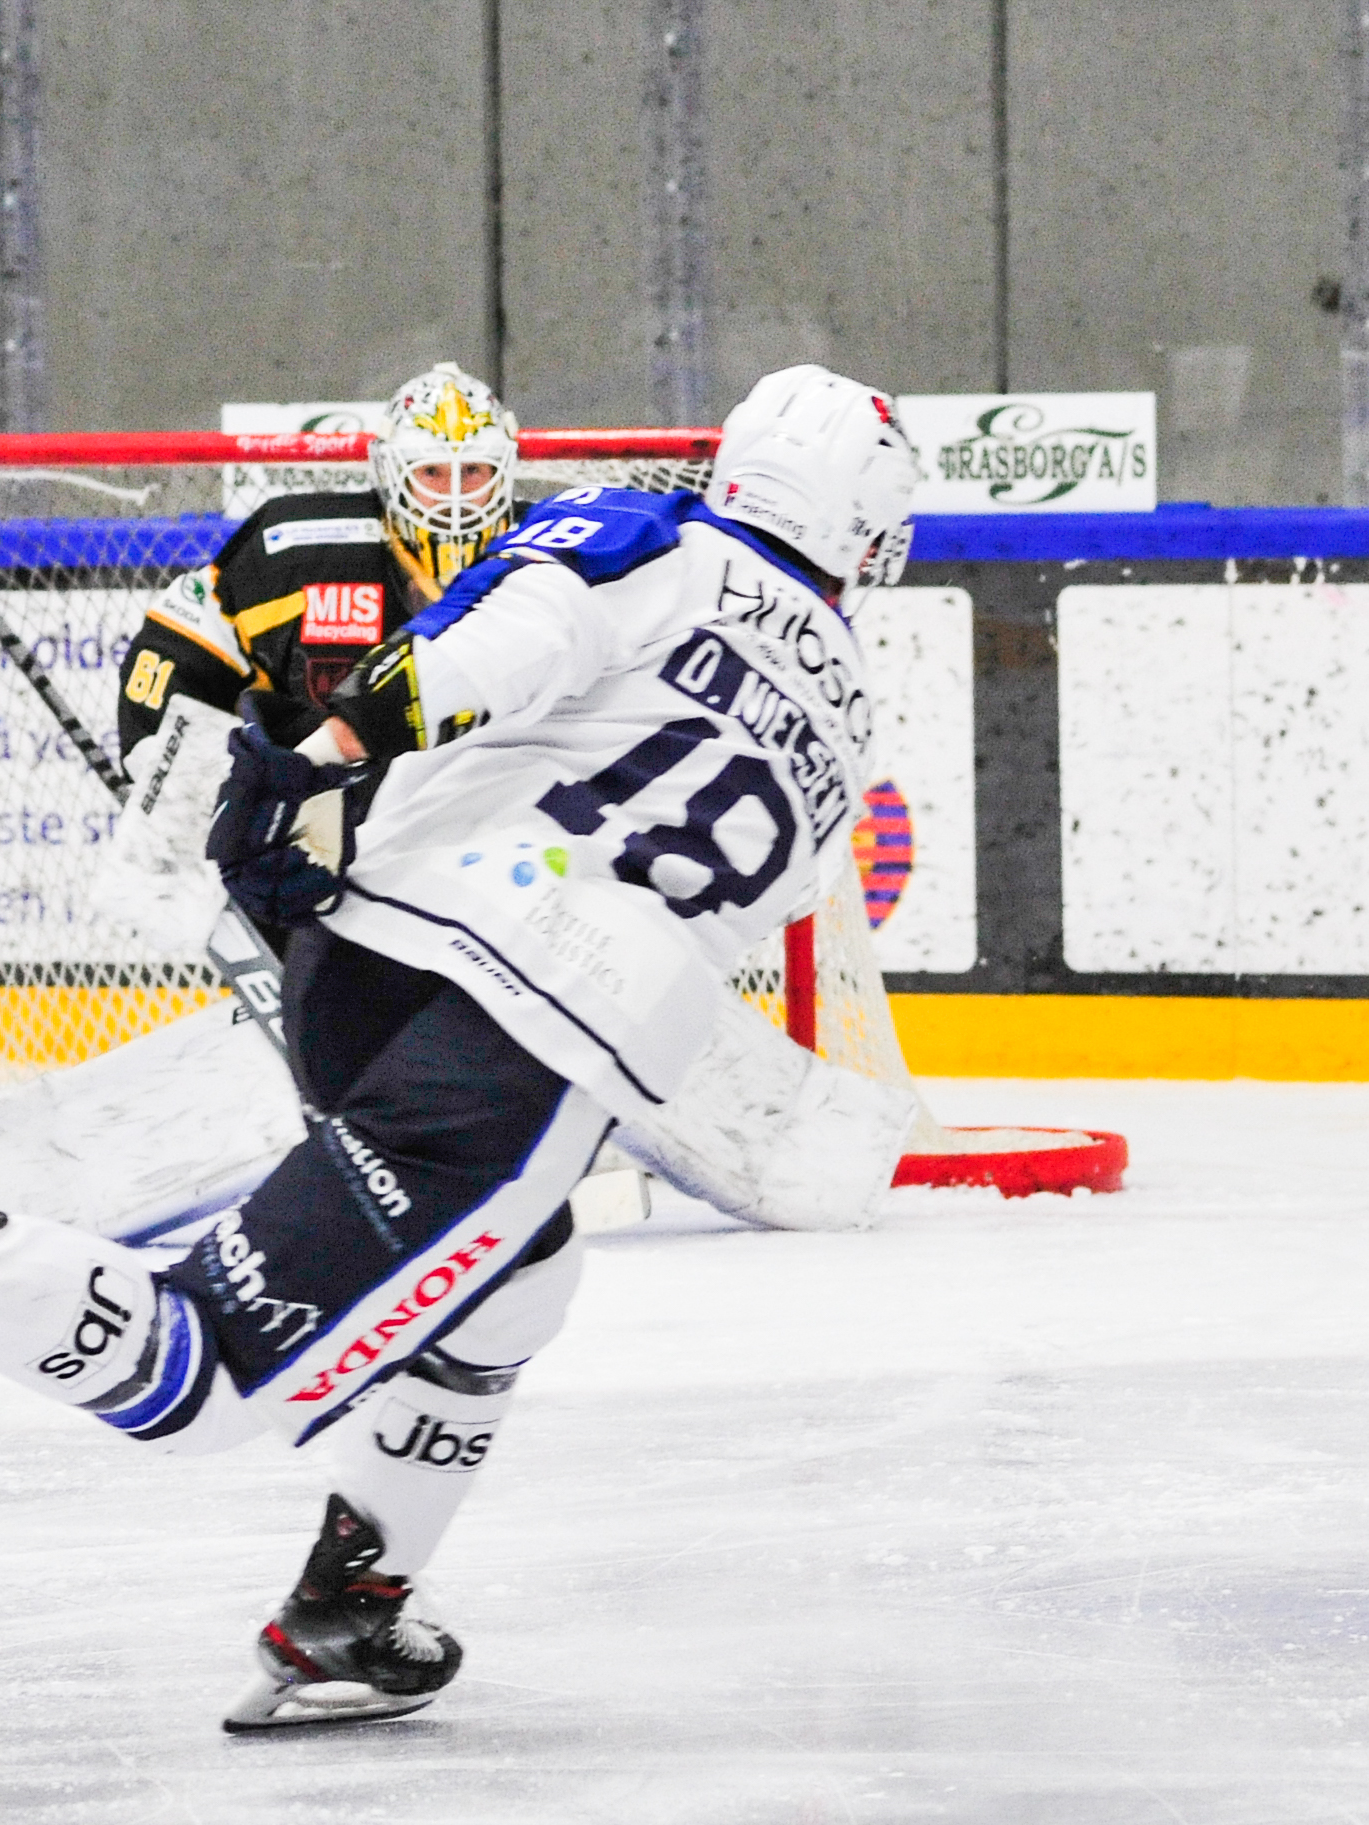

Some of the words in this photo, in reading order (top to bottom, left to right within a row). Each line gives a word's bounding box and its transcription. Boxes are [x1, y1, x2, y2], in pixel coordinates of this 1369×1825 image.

[505, 516, 605, 549] 18
[305, 585, 380, 623] MIS
[0, 621, 133, 671] olde
[304, 621, 379, 643] Recycling
[534, 716, 798, 920] 18
[284, 1229, 506, 1402] HONDA
